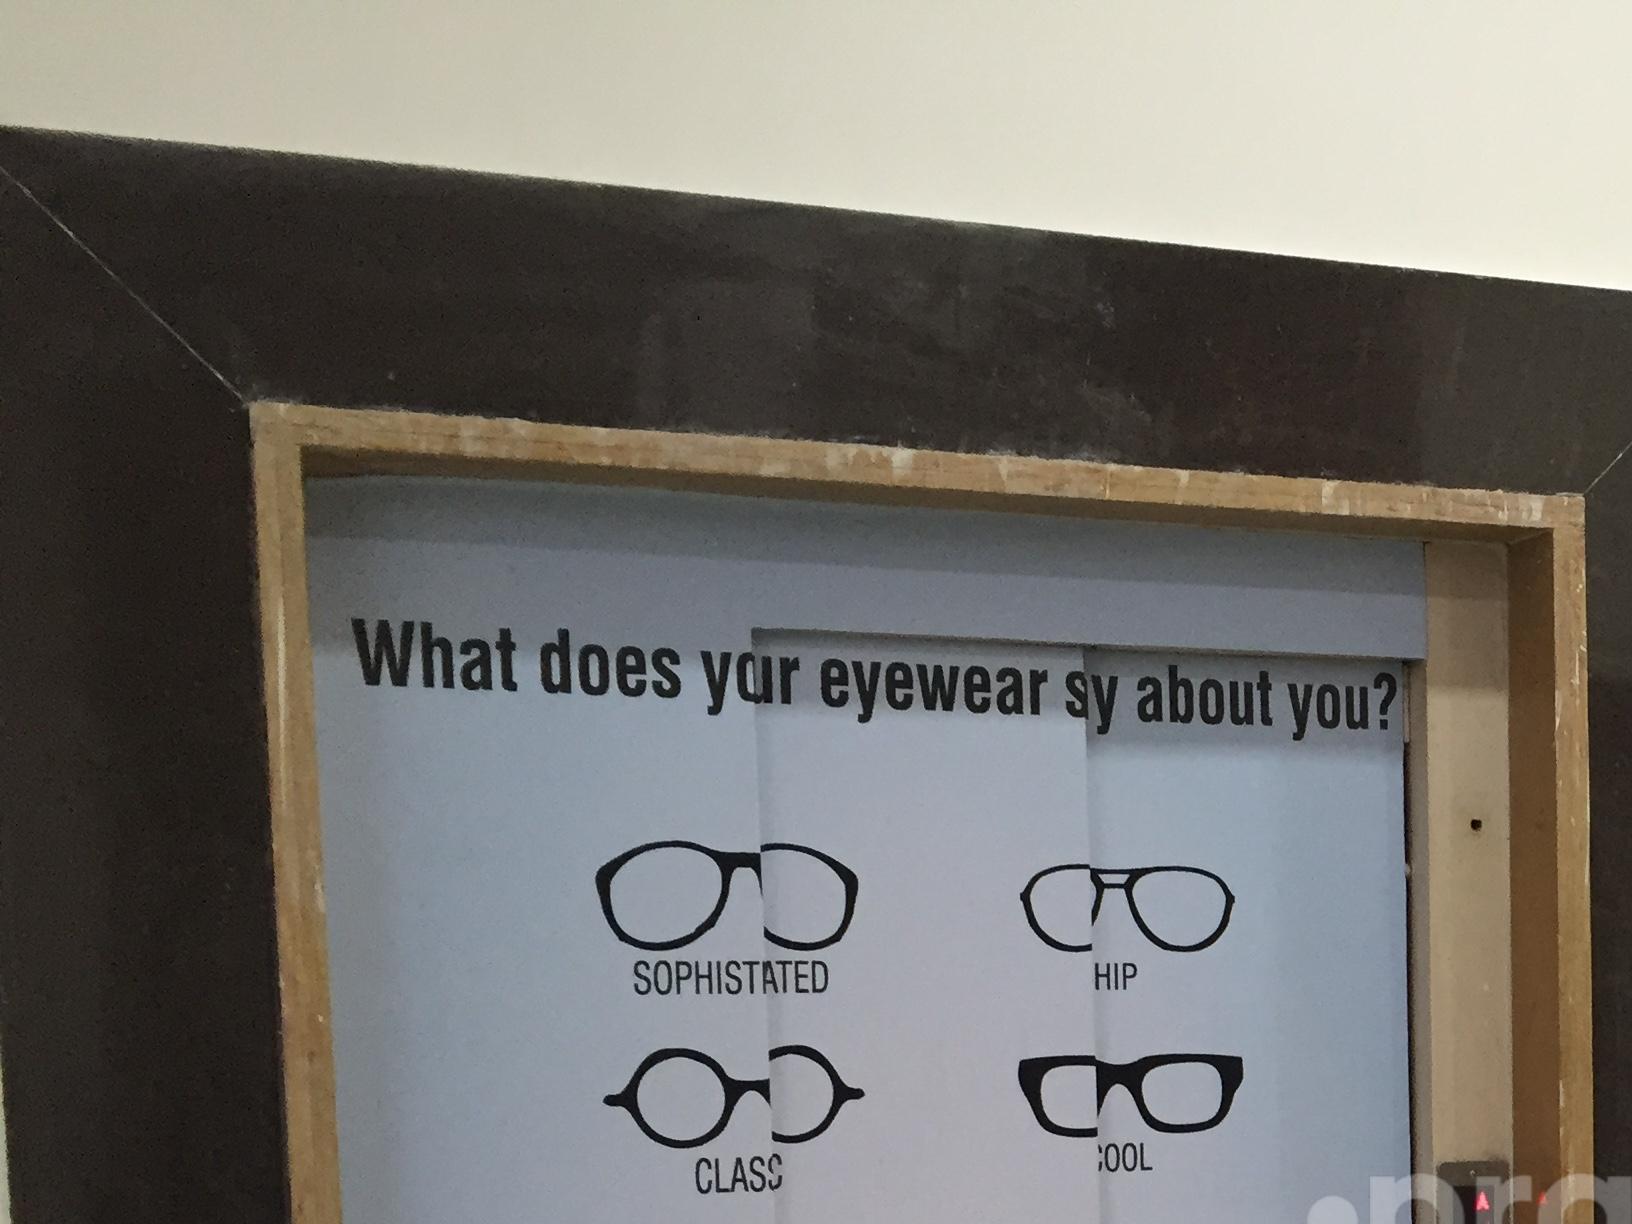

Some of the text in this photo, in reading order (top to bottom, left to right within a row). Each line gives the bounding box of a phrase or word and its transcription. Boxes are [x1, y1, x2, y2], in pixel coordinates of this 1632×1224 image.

[351, 617, 518, 692] What
[540, 628, 682, 698] does
[820, 655, 1049, 724] eyewear
[1137, 665, 1273, 726] about
[1287, 671, 1398, 741] you?
[1094, 962, 1139, 990] HIP
